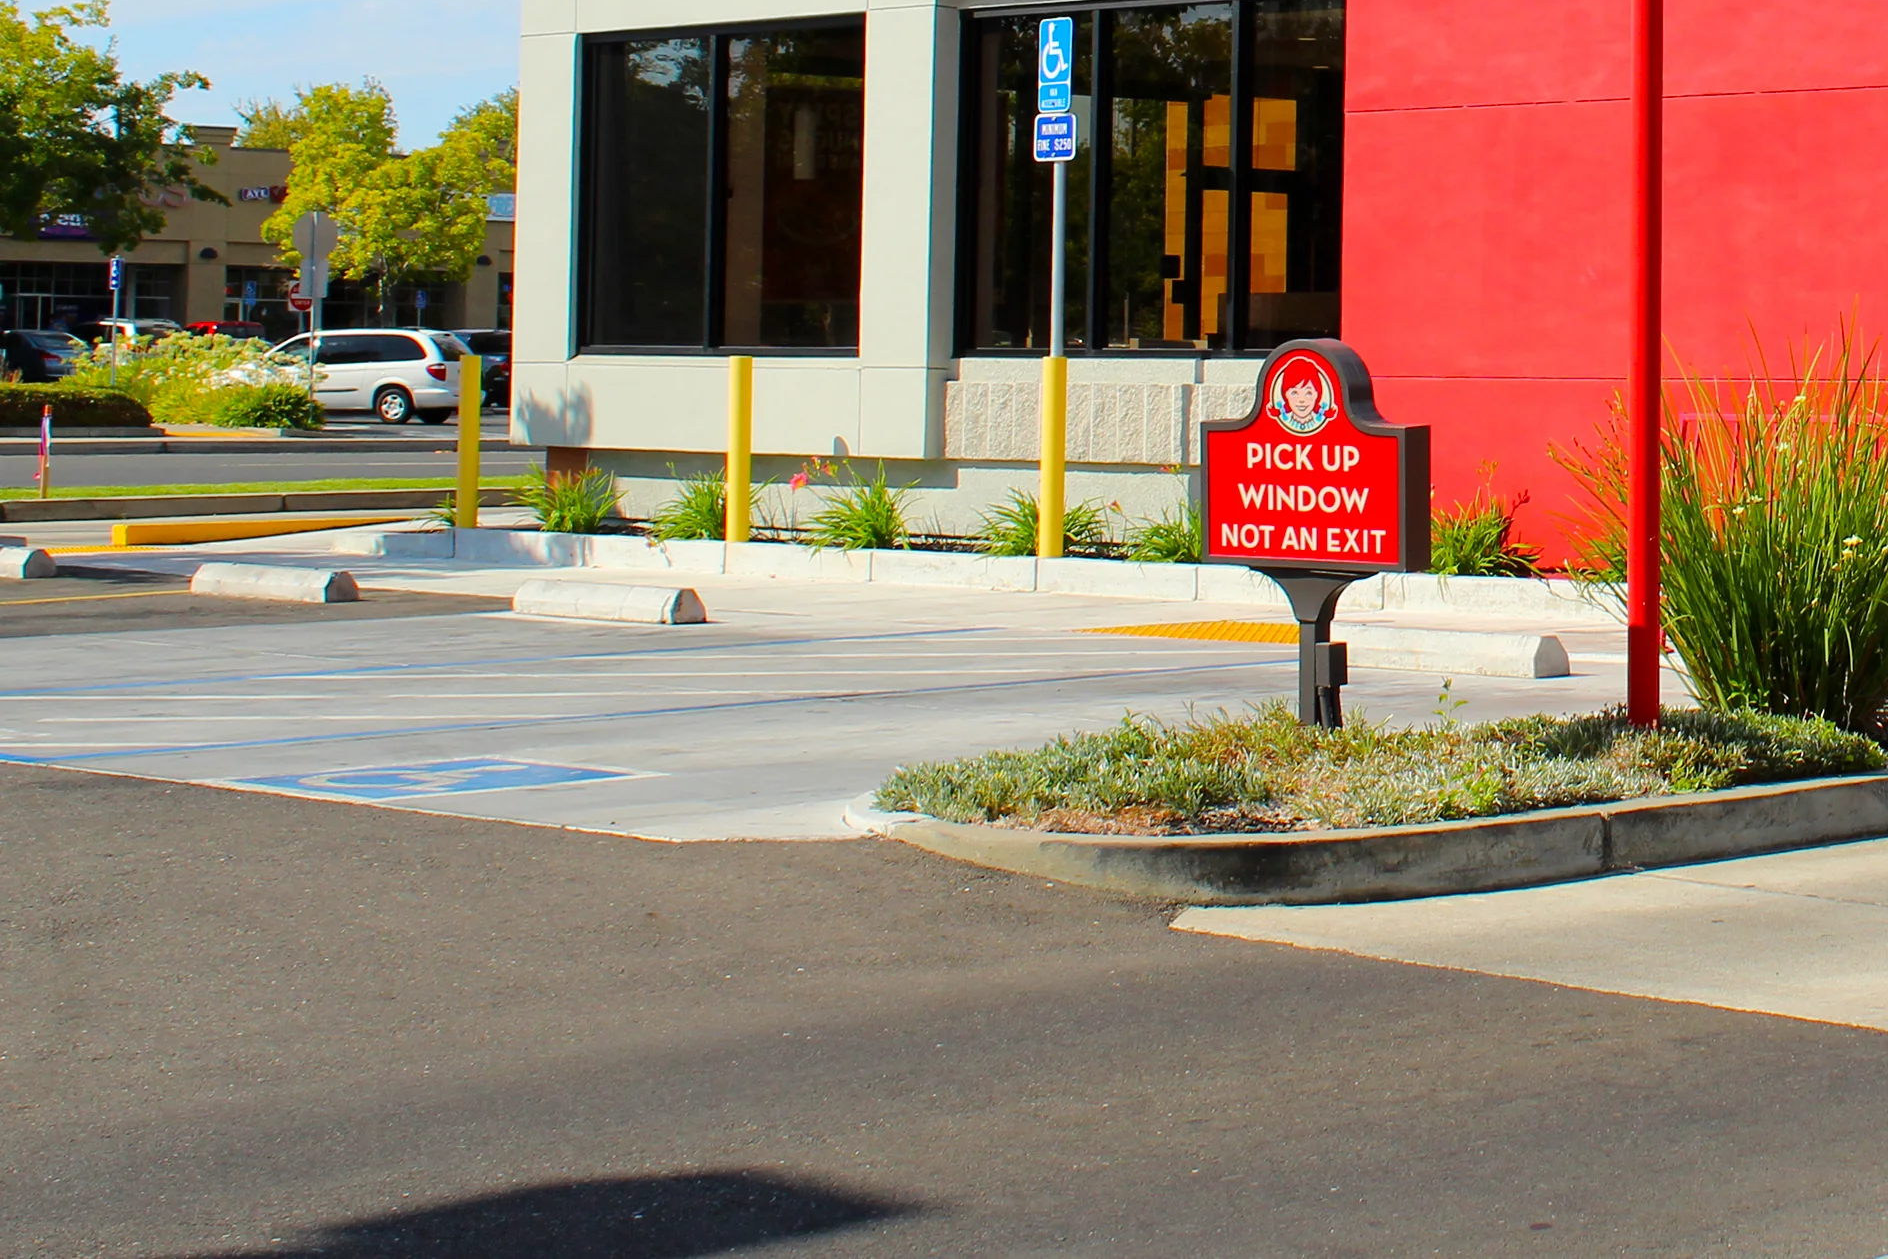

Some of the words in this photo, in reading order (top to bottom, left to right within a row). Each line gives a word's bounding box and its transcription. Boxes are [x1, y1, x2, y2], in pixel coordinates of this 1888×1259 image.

[1041, 123, 1067, 135] MINIMUM
[1037, 139, 1050, 151] FINE
[1054, 138, 1071, 151] $250
[1246, 442, 1314, 471] PICK
[1321, 444, 1360, 472] UP
[1237, 483, 1370, 515] WINDOW
[1220, 523, 1275, 550] NOT
[1281, 526, 1318, 551] AN
[1326, 528, 1387, 554] EXIT
